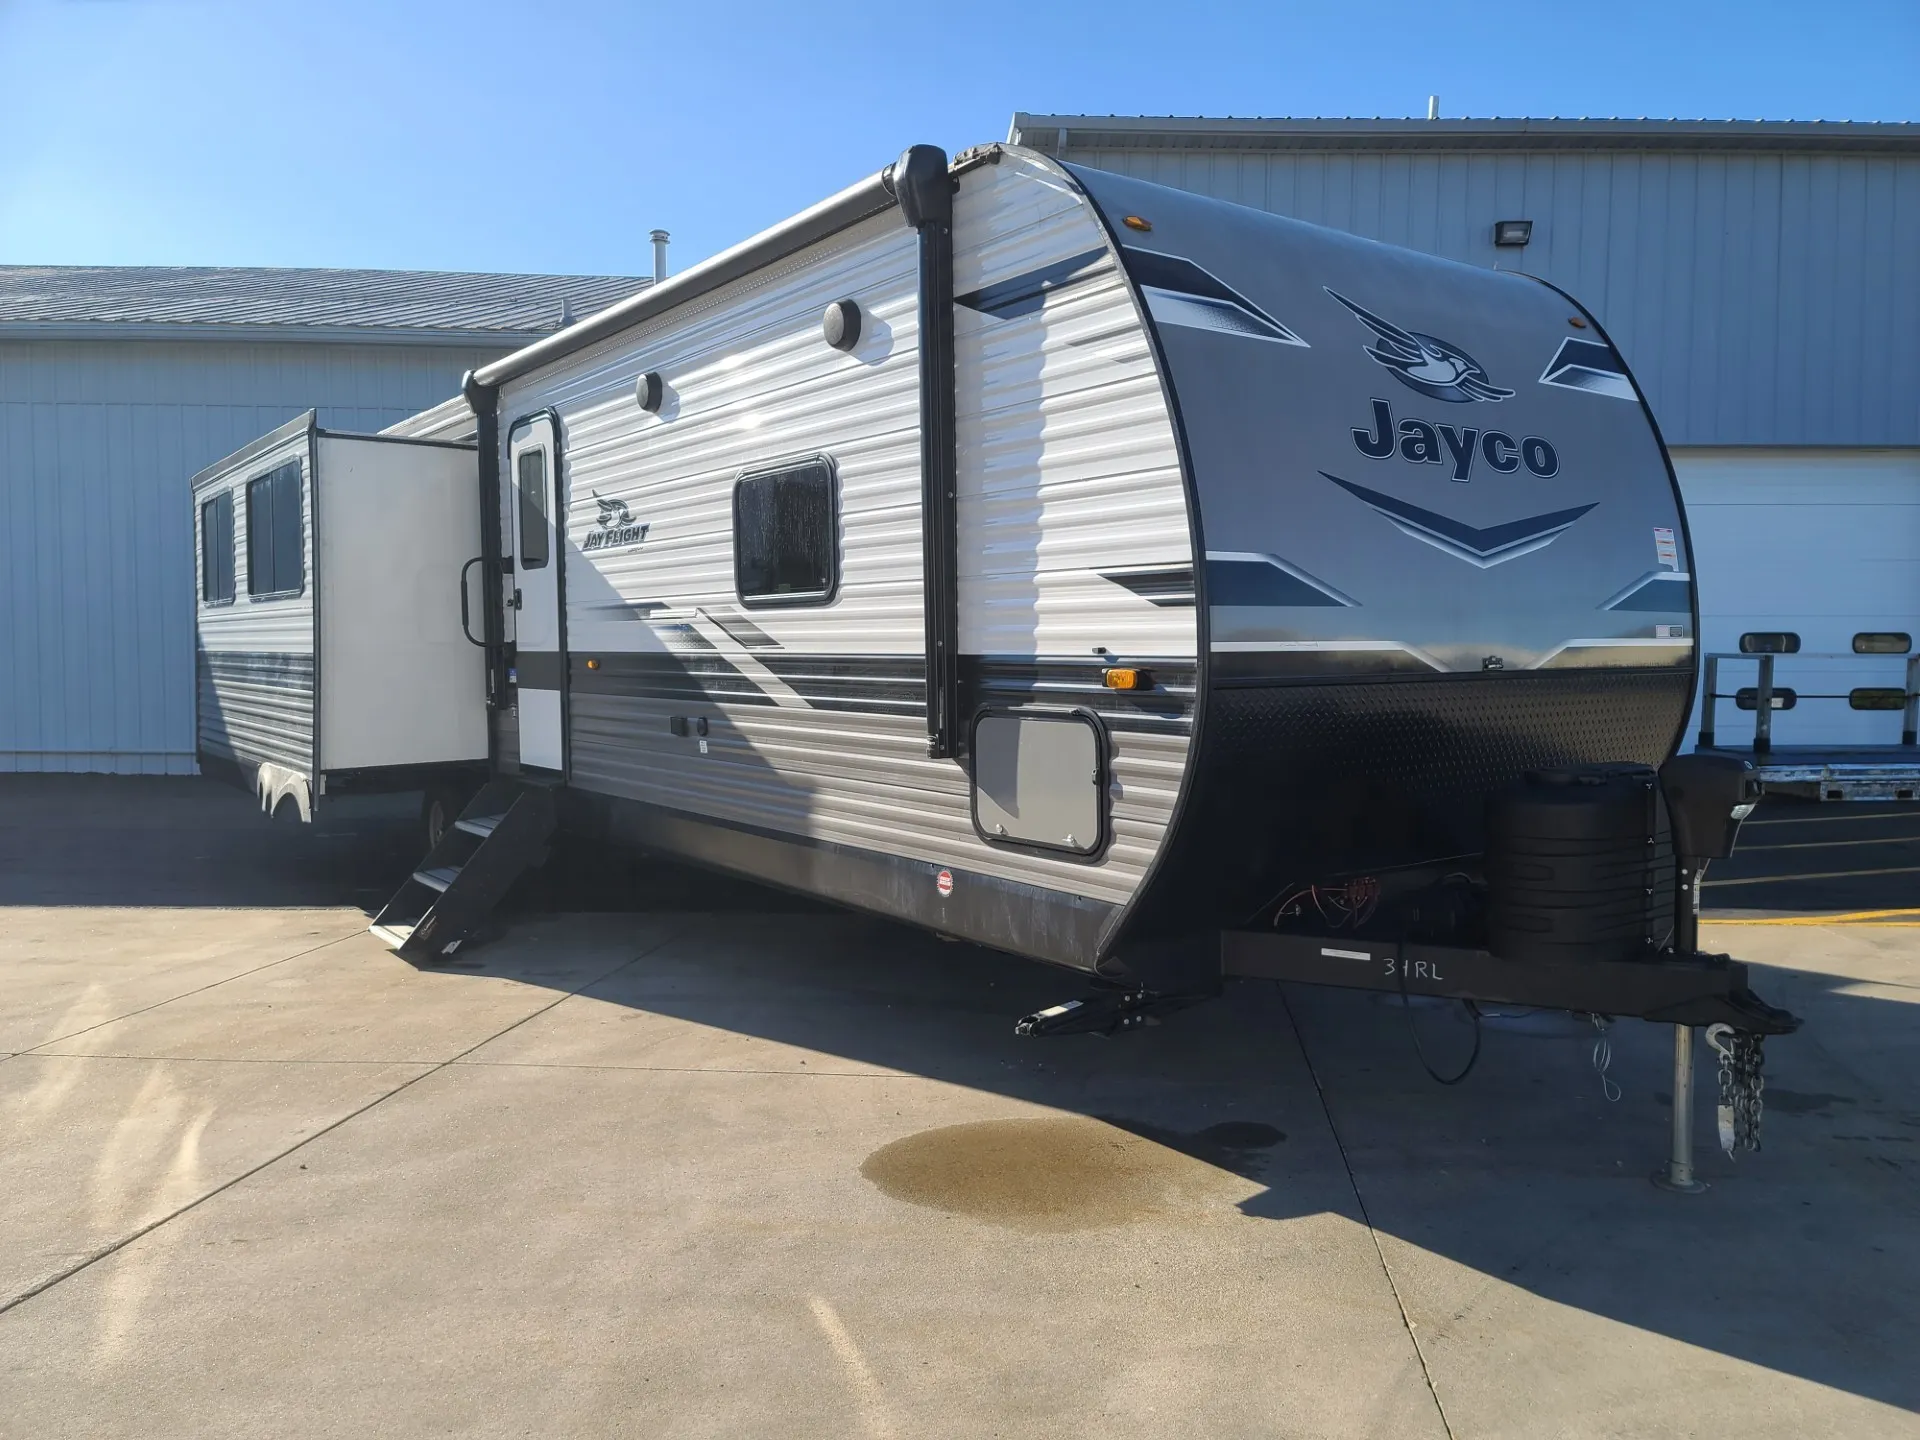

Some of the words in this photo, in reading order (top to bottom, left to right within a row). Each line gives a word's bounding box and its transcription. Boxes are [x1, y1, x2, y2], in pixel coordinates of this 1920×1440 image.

[1350, 397, 1560, 483] Jayco
[583, 530, 605, 549] JAY
[604, 524, 650, 545] FLIGHT
